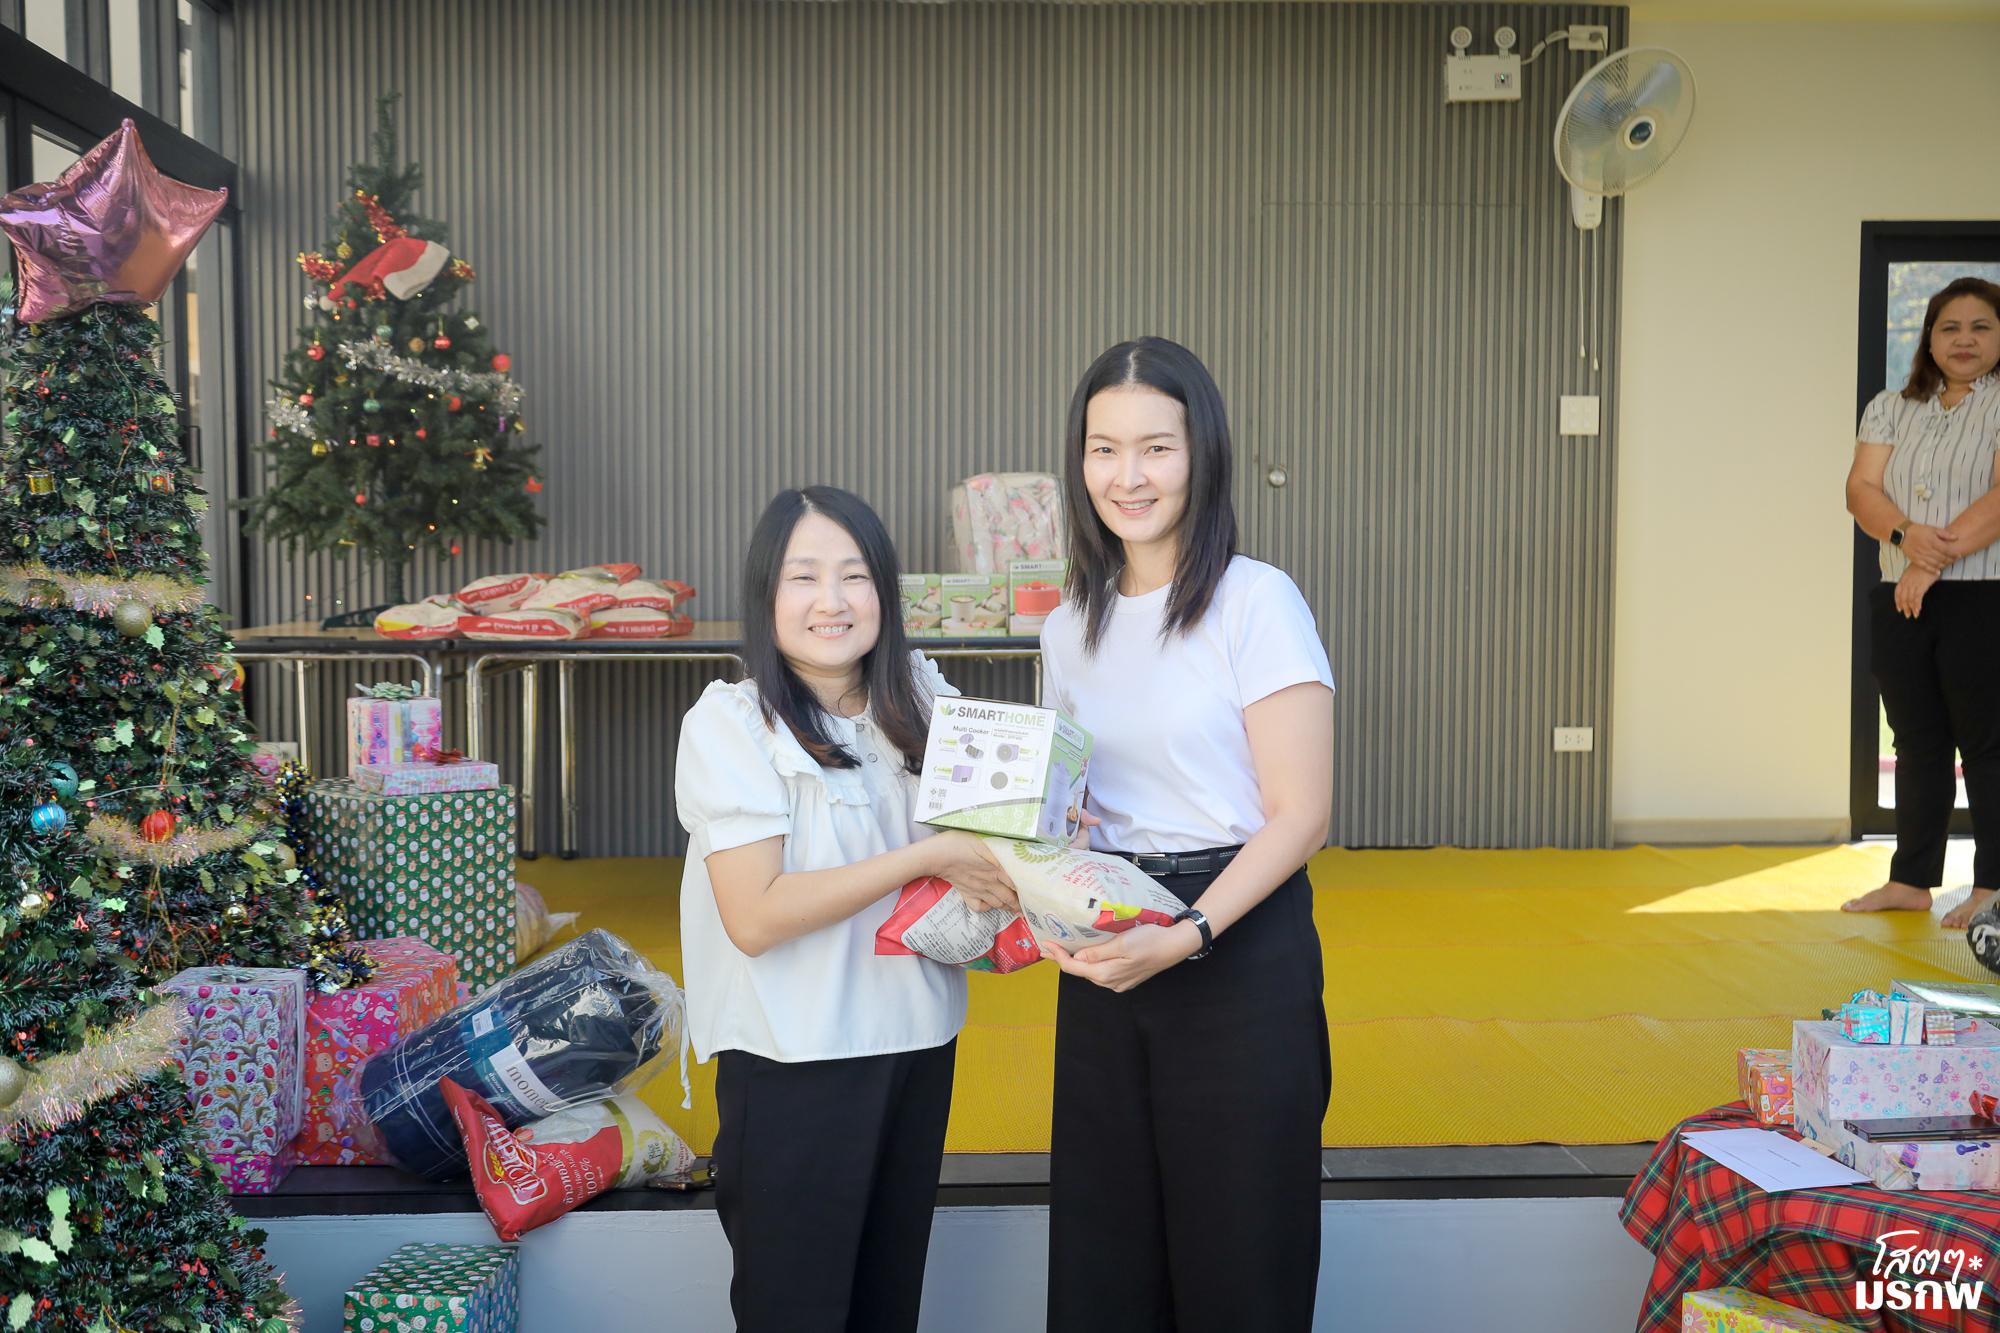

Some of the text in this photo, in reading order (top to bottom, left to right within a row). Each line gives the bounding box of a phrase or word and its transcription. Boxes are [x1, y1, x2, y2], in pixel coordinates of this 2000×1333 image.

[957, 706, 1046, 727] SMARTHOME
[953, 725, 968, 733] Multi
[968, 727, 989, 735] Cooker
[579, 1157, 598, 1194] 100%
